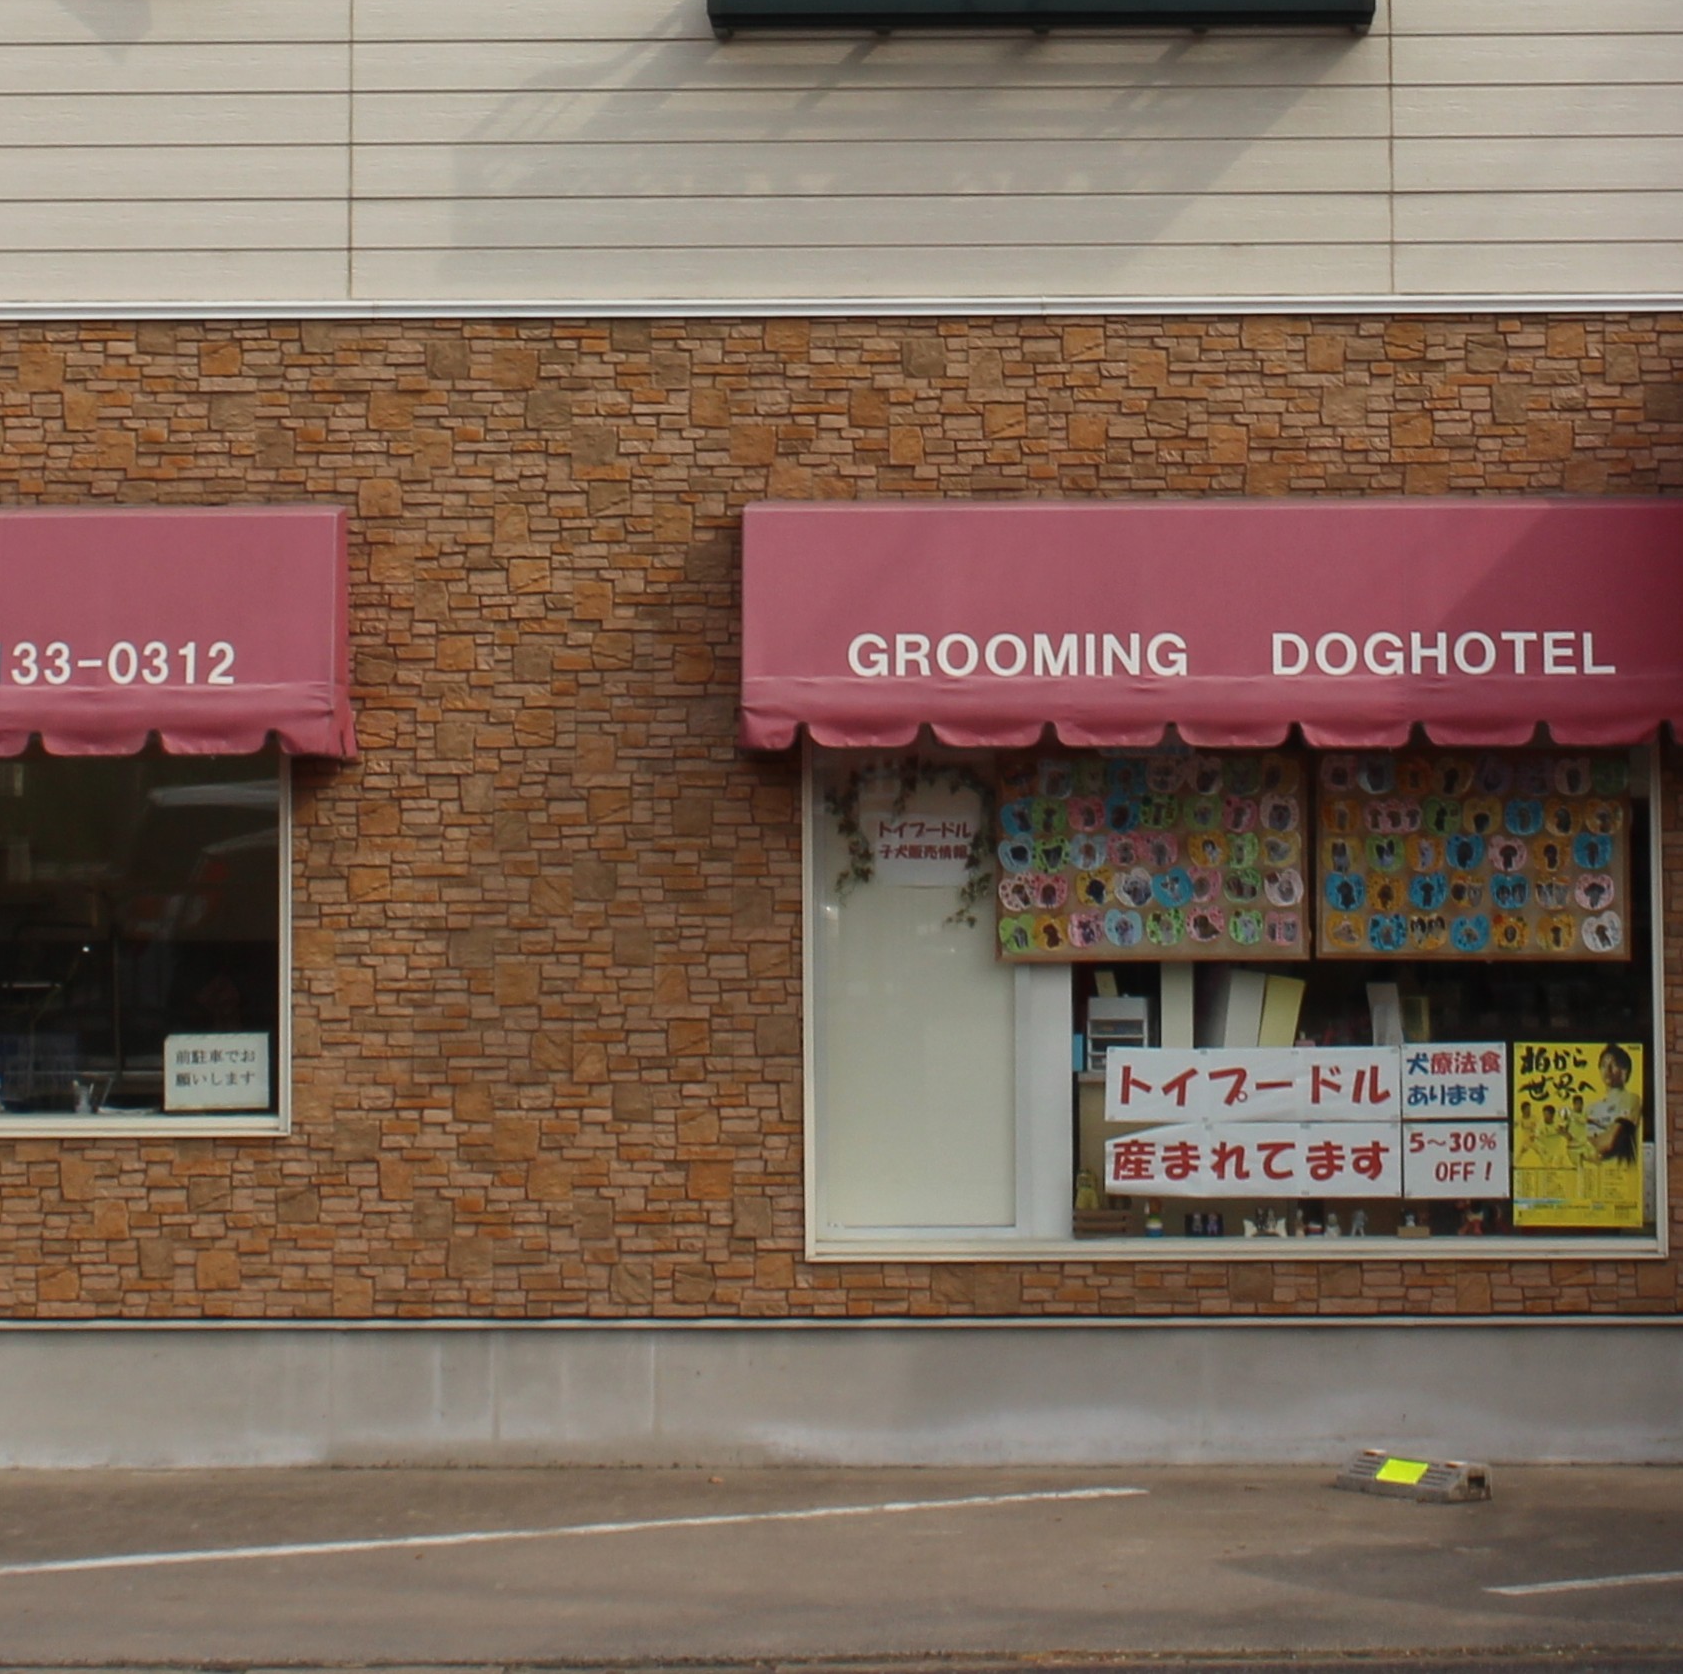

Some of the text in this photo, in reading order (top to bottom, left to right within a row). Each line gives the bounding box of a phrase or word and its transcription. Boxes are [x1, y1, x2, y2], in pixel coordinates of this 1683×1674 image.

[847, 629, 1618, 678] GROOMING DOGHOTEL
[1405, 1050, 1502, 1075] 犬療法食
[1119, 1064, 1391, 1107] トイプードル
[1406, 1082, 1490, 1107] あります
[1111, 1138, 1390, 1182] 産まれてます
